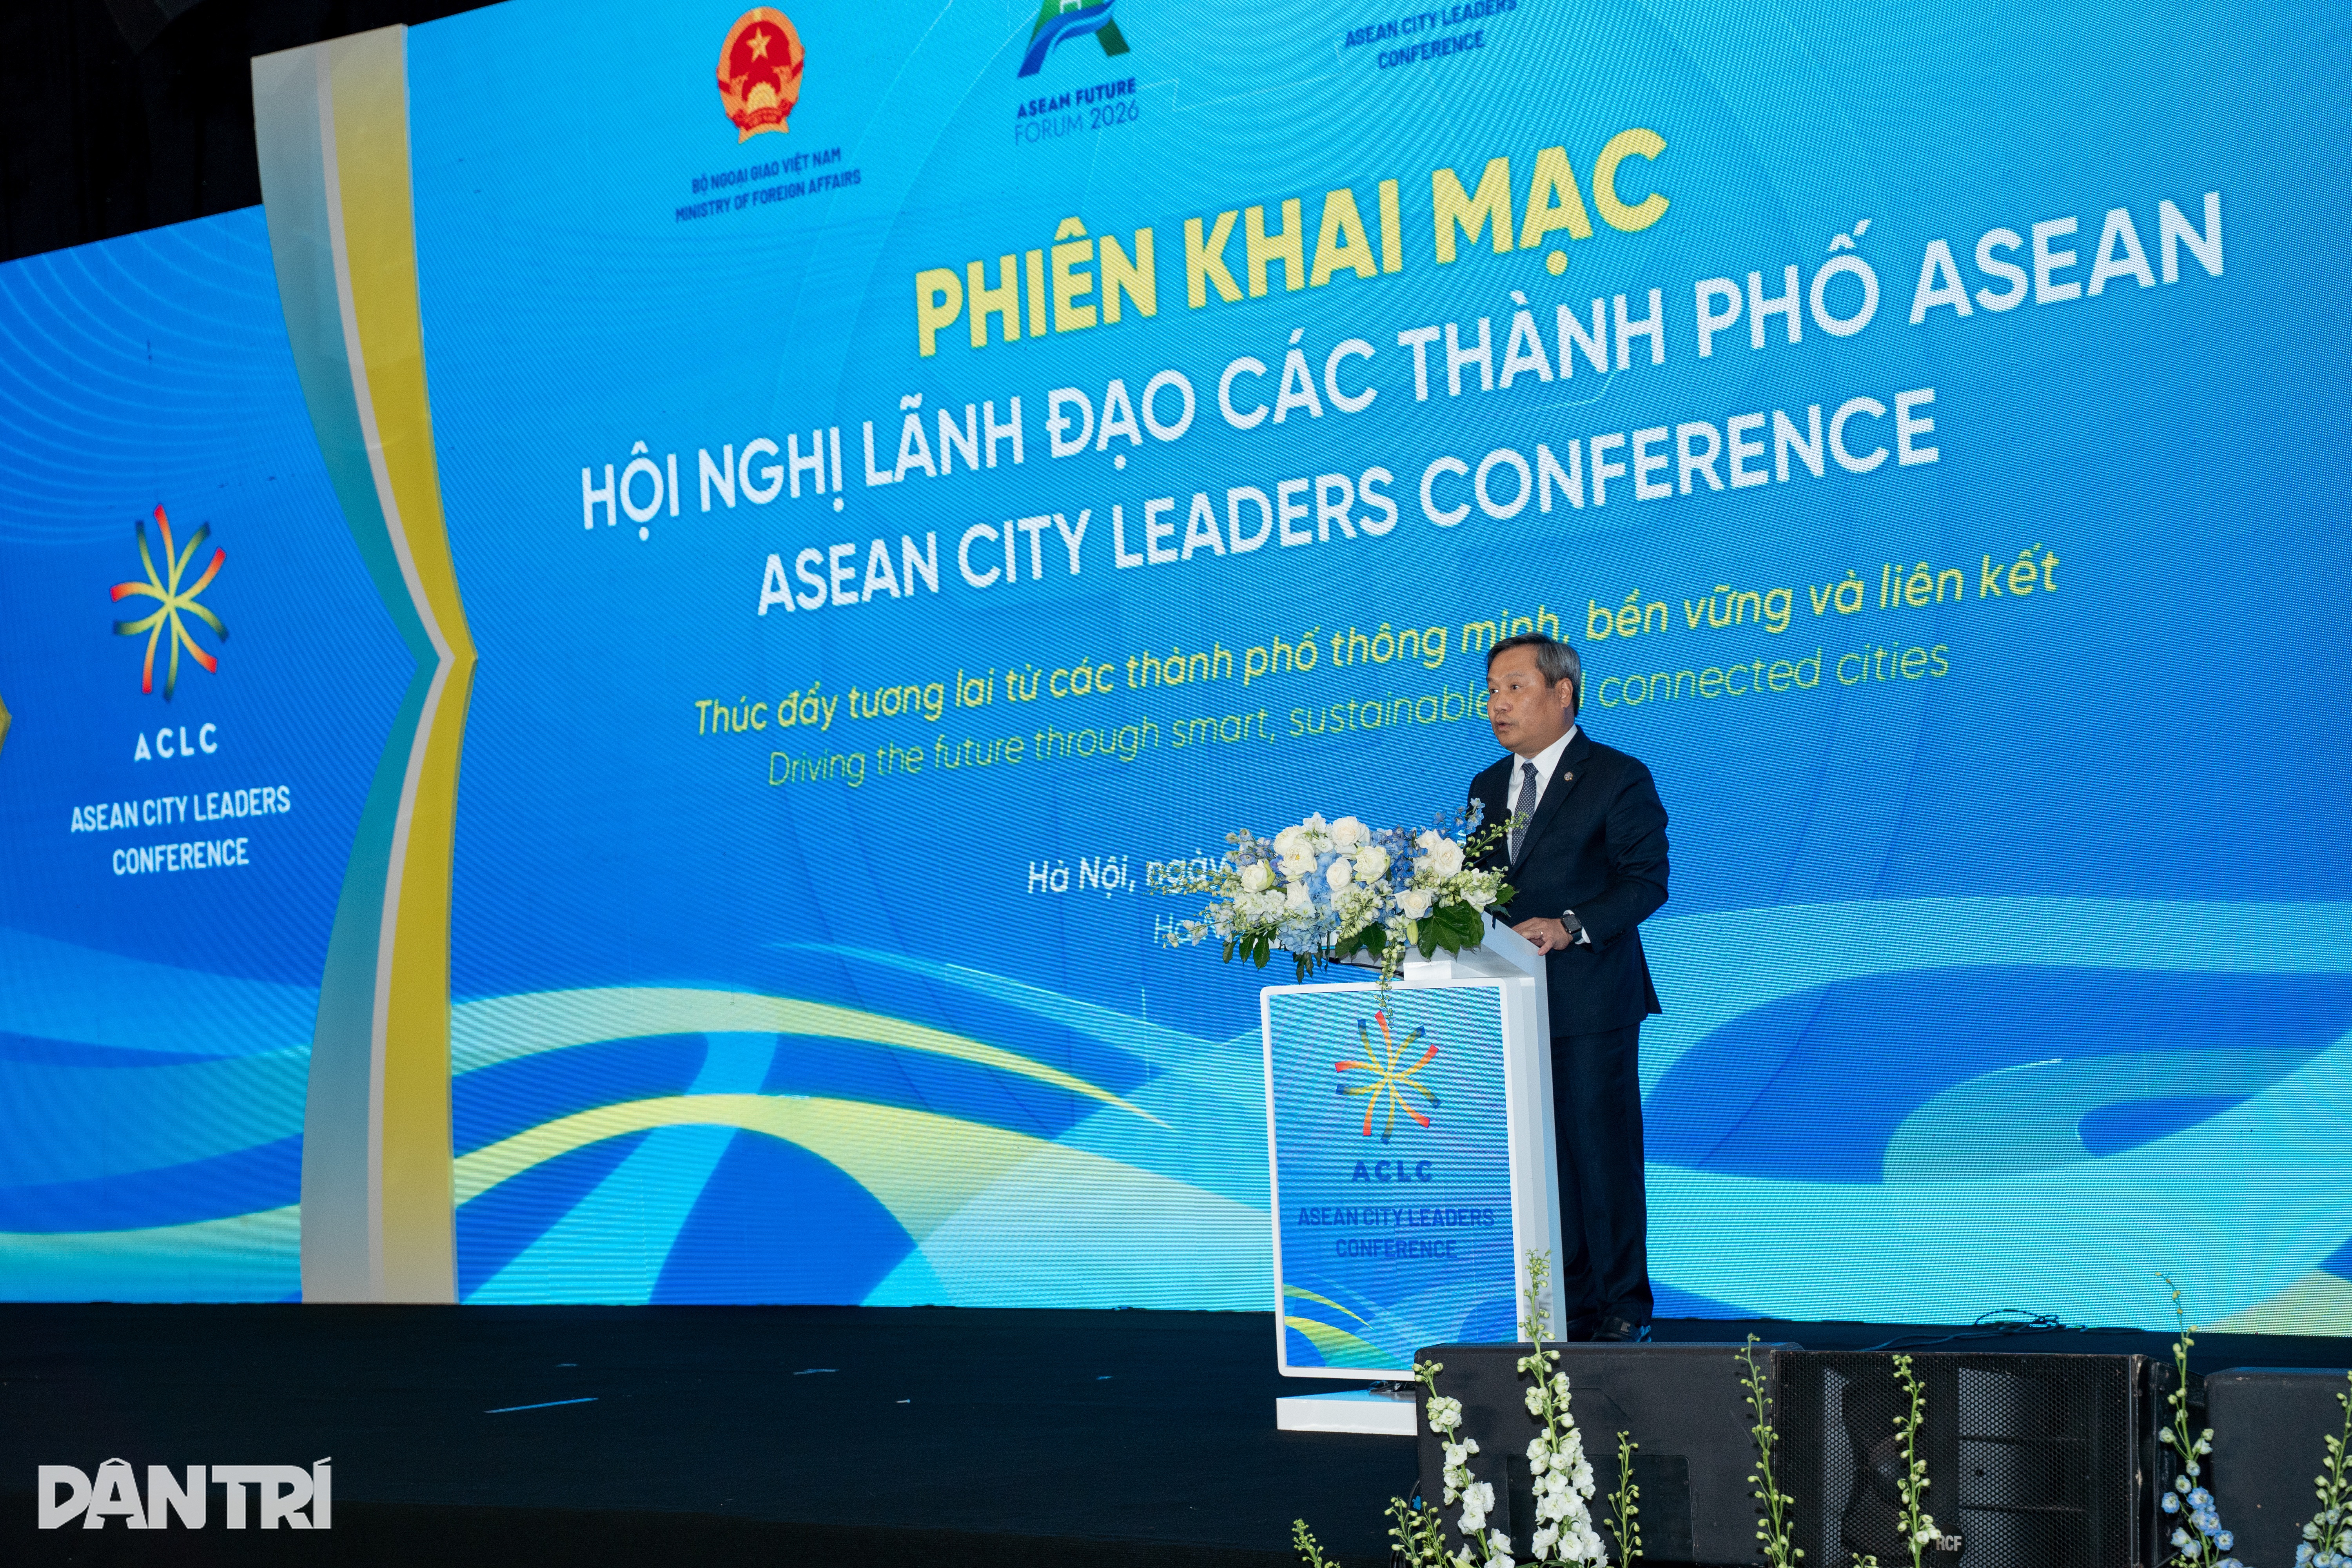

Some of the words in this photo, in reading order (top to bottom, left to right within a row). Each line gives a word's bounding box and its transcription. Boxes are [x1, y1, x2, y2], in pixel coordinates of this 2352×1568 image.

[1345, 20, 1398, 48] ASEAN
[1402, 11, 1437, 35] CITY
[1441, 0, 1517, 26] LEADERS
[1378, 29, 1485, 69] CONFERENCE
[1017, 91, 1071, 118] ASEAN
[1076, 77, 1136, 105] FUTURE
[1014, 113, 1083, 146] FORUM
[1090, 98, 1139, 130] 2026
[691, 173, 708, 196] BỘ
[710, 168, 748, 188] NGOẠI
[750, 161, 779, 181] GIAO
[782, 152, 809, 175] VIỆT
[812, 147, 841, 167] NAM
[675, 197, 731, 223] MINISTRY
[734, 193, 750, 211] OF
[752, 181, 806, 207] FOREIGN
[808, 169, 862, 195] AFFAIRS
[915, 216, 1157, 357] PHIÊN
[1183, 178, 1403, 309] KHAI
[1431, 127, 1670, 276] MẠC
[581, 440, 680, 541] HỘI
[698, 426, 844, 512] NGHỊ
[862, 392, 1024, 487] LÃNH
[1045, 369, 1196, 470] ĐẠO
[1217, 327, 1378, 430] CÁC
[1397, 287, 1666, 402] THÀNH
[1695, 218, 1880, 358] PHỐ
[1909, 191, 2223, 325] ASEAN
[757, 531, 939, 616] ASEAN
[957, 508, 1092, 588] CITY
[1112, 466, 1399, 569] LEADERS
[1419, 388, 1939, 527] CONFERENCE
[695, 696, 768, 735] Thúc
[848, 682, 944, 722] tương
[955, 668, 994, 708] lai
[1005, 664, 1042, 702] từ
[1049, 657, 1114, 698] các
[1126, 641, 1233, 689] thành
[1243, 625, 1320, 687] phố
[1330, 622, 1448, 670] thông
[1684, 584, 1793, 634] vững
[1809, 569, 1865, 616] và
[1880, 561, 1964, 609] liên
[1980, 543, 2060, 598] kết
[769, 750, 865, 787] Driving
[877, 742, 924, 774] the
[935, 734, 1024, 769] future
[1035, 716, 1159, 762] through
[1172, 708, 1275, 748] smart,
[1290, 681, 1489, 736] sustainable
[1599, 648, 1822, 708] connected
[1837, 642, 1949, 685] cities
[134, 723, 218, 761] ACLC
[71, 801, 138, 833] ASEAN
[143, 796, 187, 826] CITY
[194, 785, 291, 821] LEADERS
[113, 837, 249, 875] CONFERENCE
[1028, 860, 1069, 893] Hà
[1079, 855, 1136, 899] Nội,
[1351, 1160, 1433, 1182] ACLC
[1298, 1207, 1358, 1225] ASEAN
[1363, 1207, 1403, 1226] CITY
[1409, 1208, 1495, 1227] LEADERS
[1336, 1238, 1457, 1259] CONFERENCE
[1936, 1535, 1962, 1552] RCF
